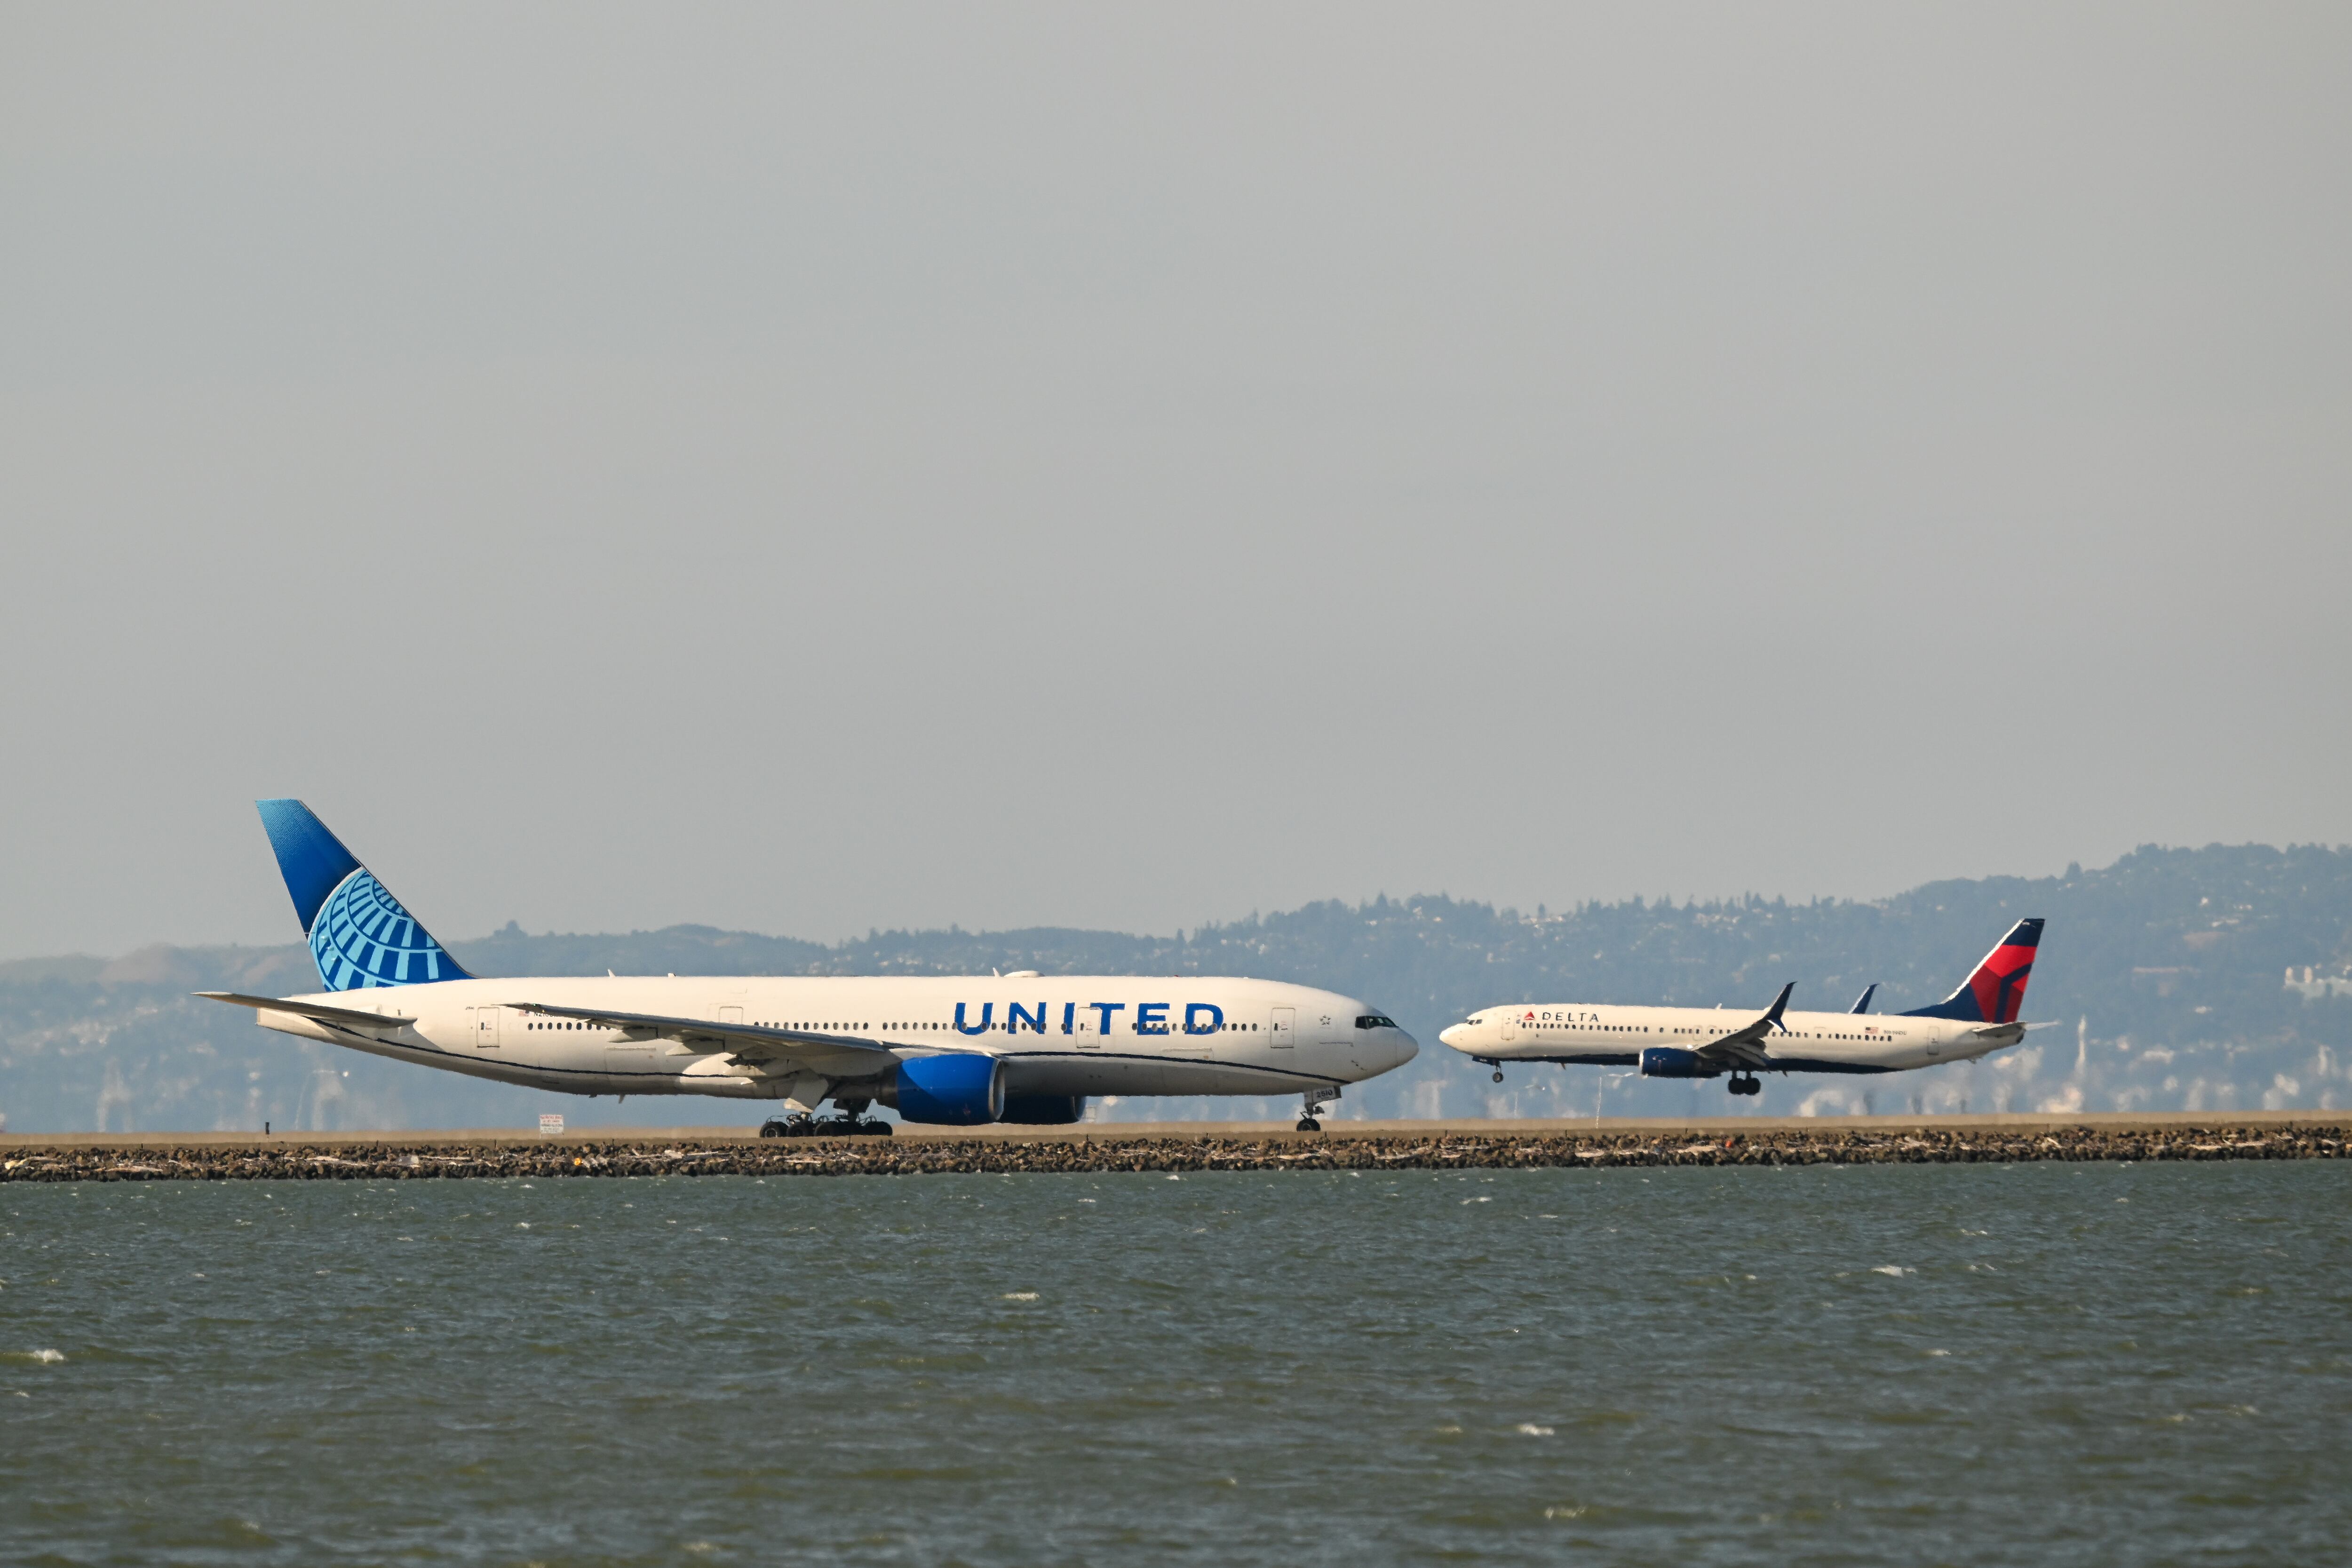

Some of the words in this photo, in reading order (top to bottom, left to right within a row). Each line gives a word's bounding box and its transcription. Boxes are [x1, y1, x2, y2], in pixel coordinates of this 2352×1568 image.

[954, 1002, 1224, 1035] UNITED
[1542, 1012, 1598, 1022] DELTA
[1317, 1089, 1333, 1098] 2510
